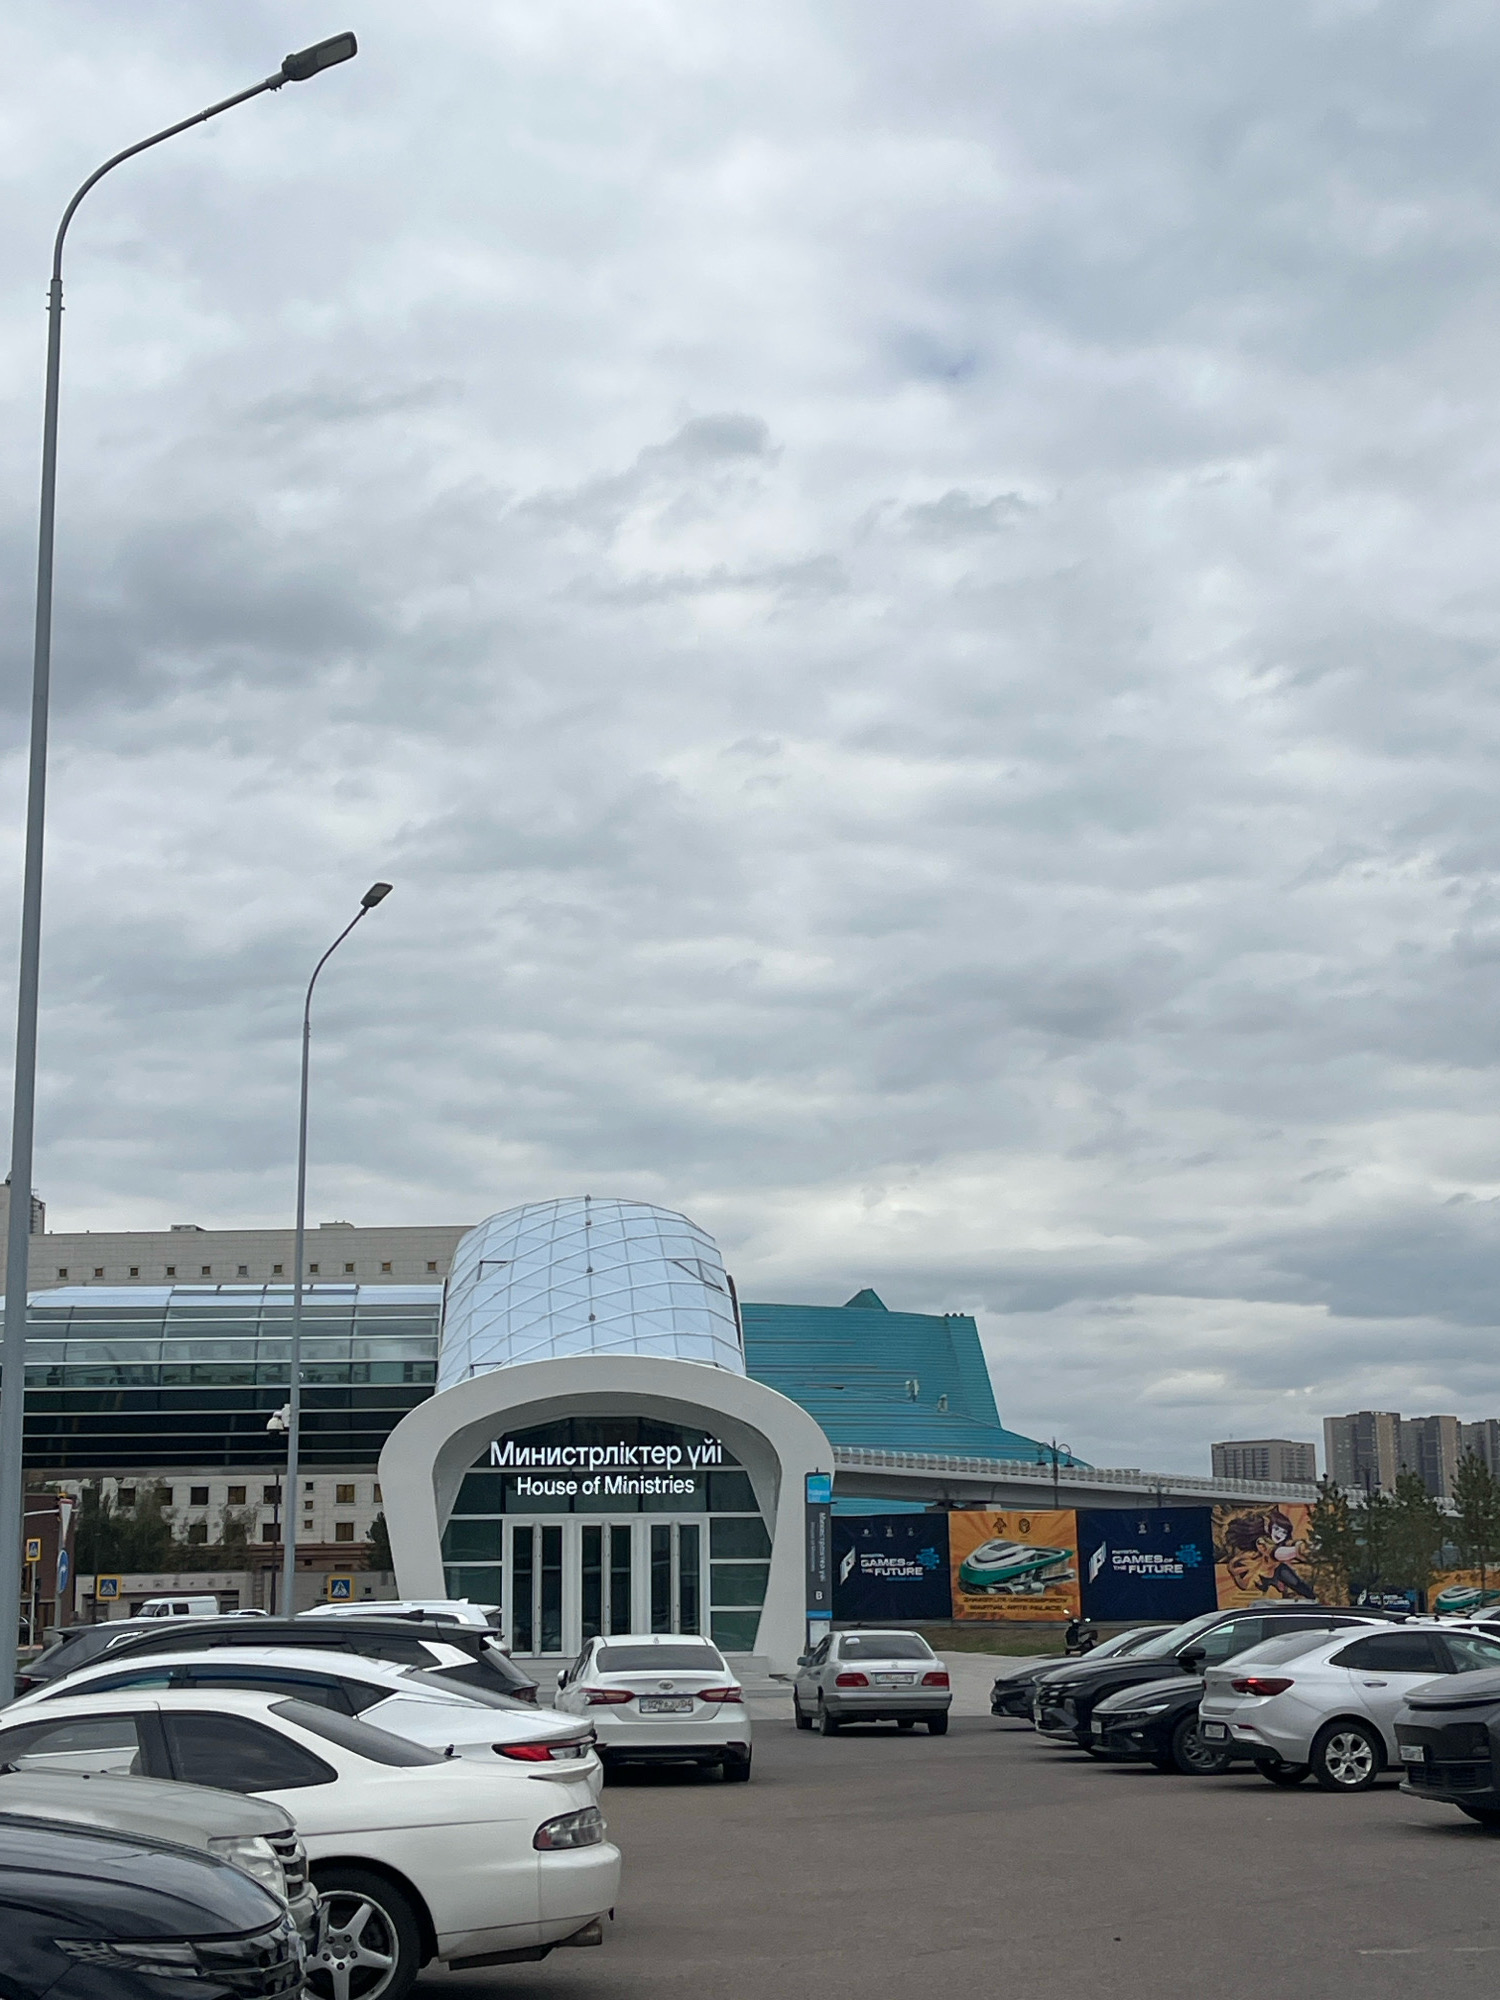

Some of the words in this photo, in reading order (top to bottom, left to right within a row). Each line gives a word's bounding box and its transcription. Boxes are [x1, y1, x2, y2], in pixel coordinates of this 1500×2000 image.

[490, 1440, 681, 1471] Министрліктер
[687, 1438, 722, 1470] үйі
[517, 1476, 577, 1496] House
[582, 1476, 600, 1495] of
[604, 1475, 695, 1495] Ministries
[860, 1558, 906, 1567] GAMES
[1112, 1554, 1163, 1564] GAMES
[874, 1567, 924, 1576] FUTURE
[1128, 1564, 1184, 1574] FUTURE
